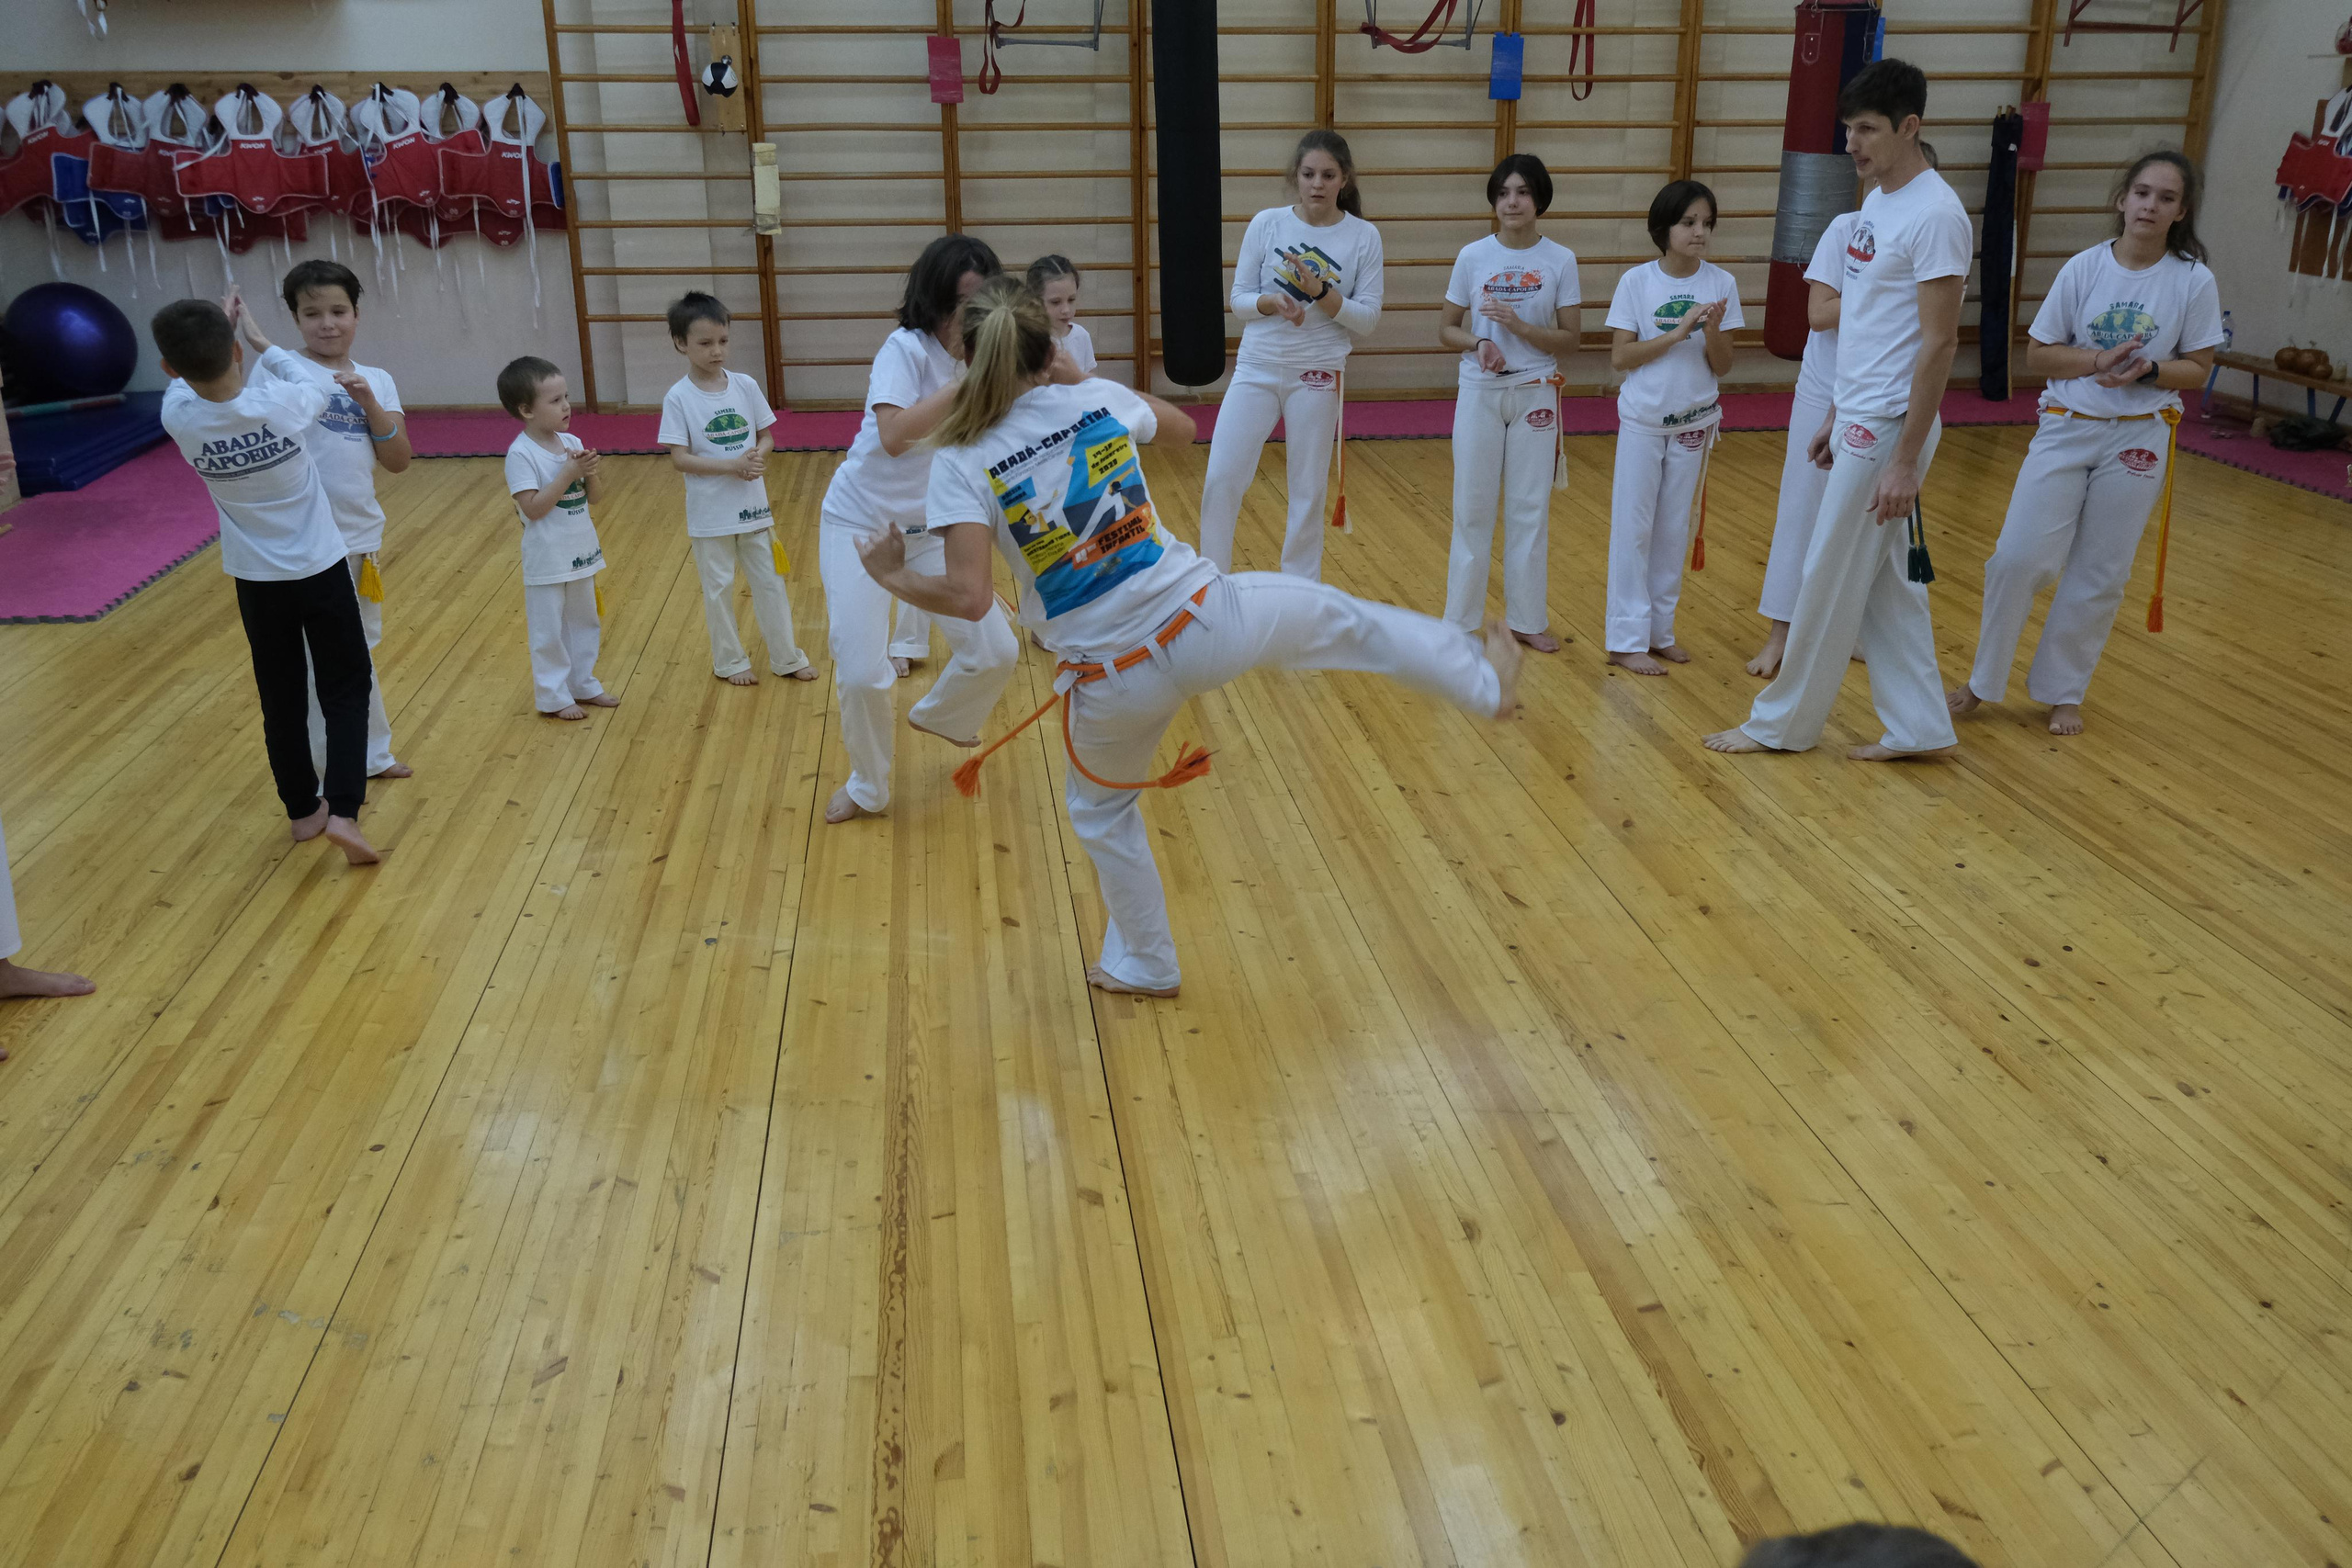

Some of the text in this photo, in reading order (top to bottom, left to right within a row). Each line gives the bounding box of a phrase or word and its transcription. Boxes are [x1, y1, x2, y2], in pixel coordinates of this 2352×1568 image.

[392, 137, 416, 150] KWON
[2109, 301, 2145, 311] SAMARA
[193, 436, 297, 471] CAPOEIRA
[201, 423, 277, 456] ABADÁ
[989, 407, 1112, 479] ABADÁ-CAPOEIRA
[1098, 458, 1118, 475] 2020
[1097, 516, 1142, 546] FESTIVAL
[1100, 525, 1145, 554] INFANTIL
